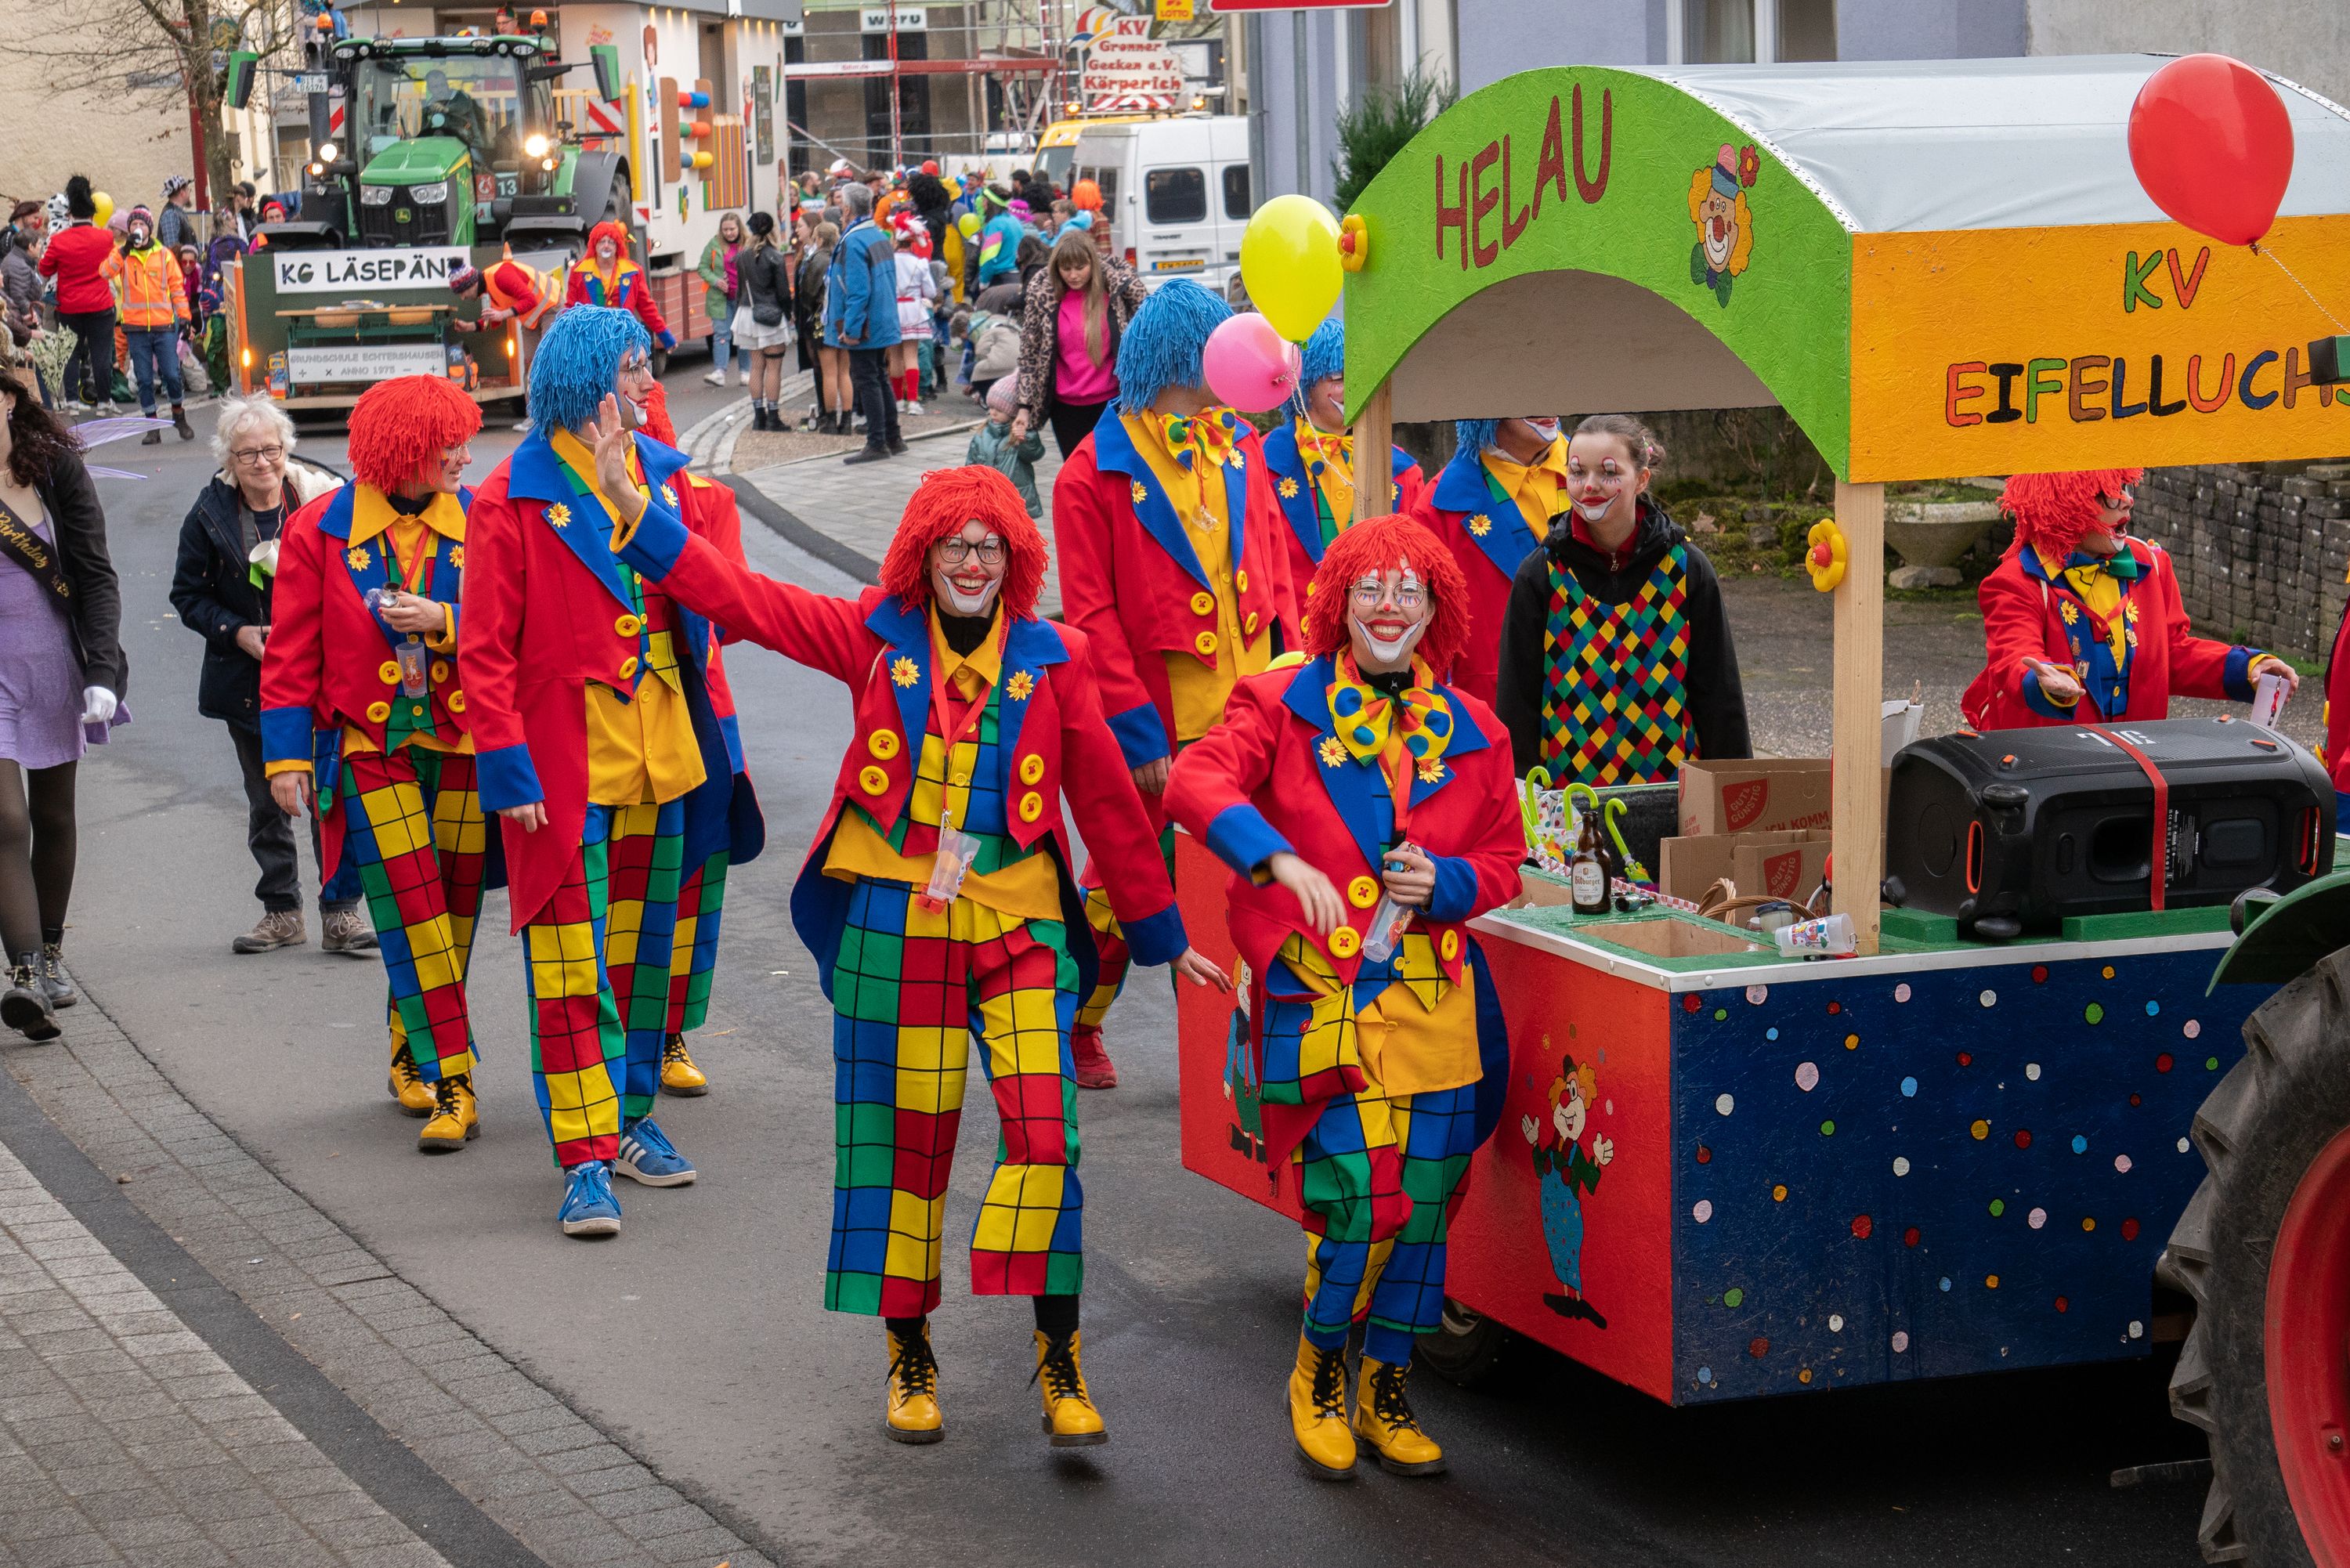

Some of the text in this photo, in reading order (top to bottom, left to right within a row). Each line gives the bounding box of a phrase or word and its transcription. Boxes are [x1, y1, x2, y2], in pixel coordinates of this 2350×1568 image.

[1117, 20, 1148, 36] KV
[1087, 59, 1177, 70] Gecken e.V.
[1083, 75, 1181, 92] Körperich
[1436, 82, 1612, 271] HELAU
[497, 179, 517, 196] 13
[281, 254, 453, 284] KG LÄSEPÄN
[2124, 246, 2210, 313] KV
[291, 353, 359, 364] GRUNDSCHULE
[341, 367, 369, 376] ANNO
[1730, 784, 1761, 823] GÜNSTIG
[1791, 810, 1829, 831] KOMM
[1574, 876, 1600, 887] Bitburger
[574, 1162, 595, 1172] didas
